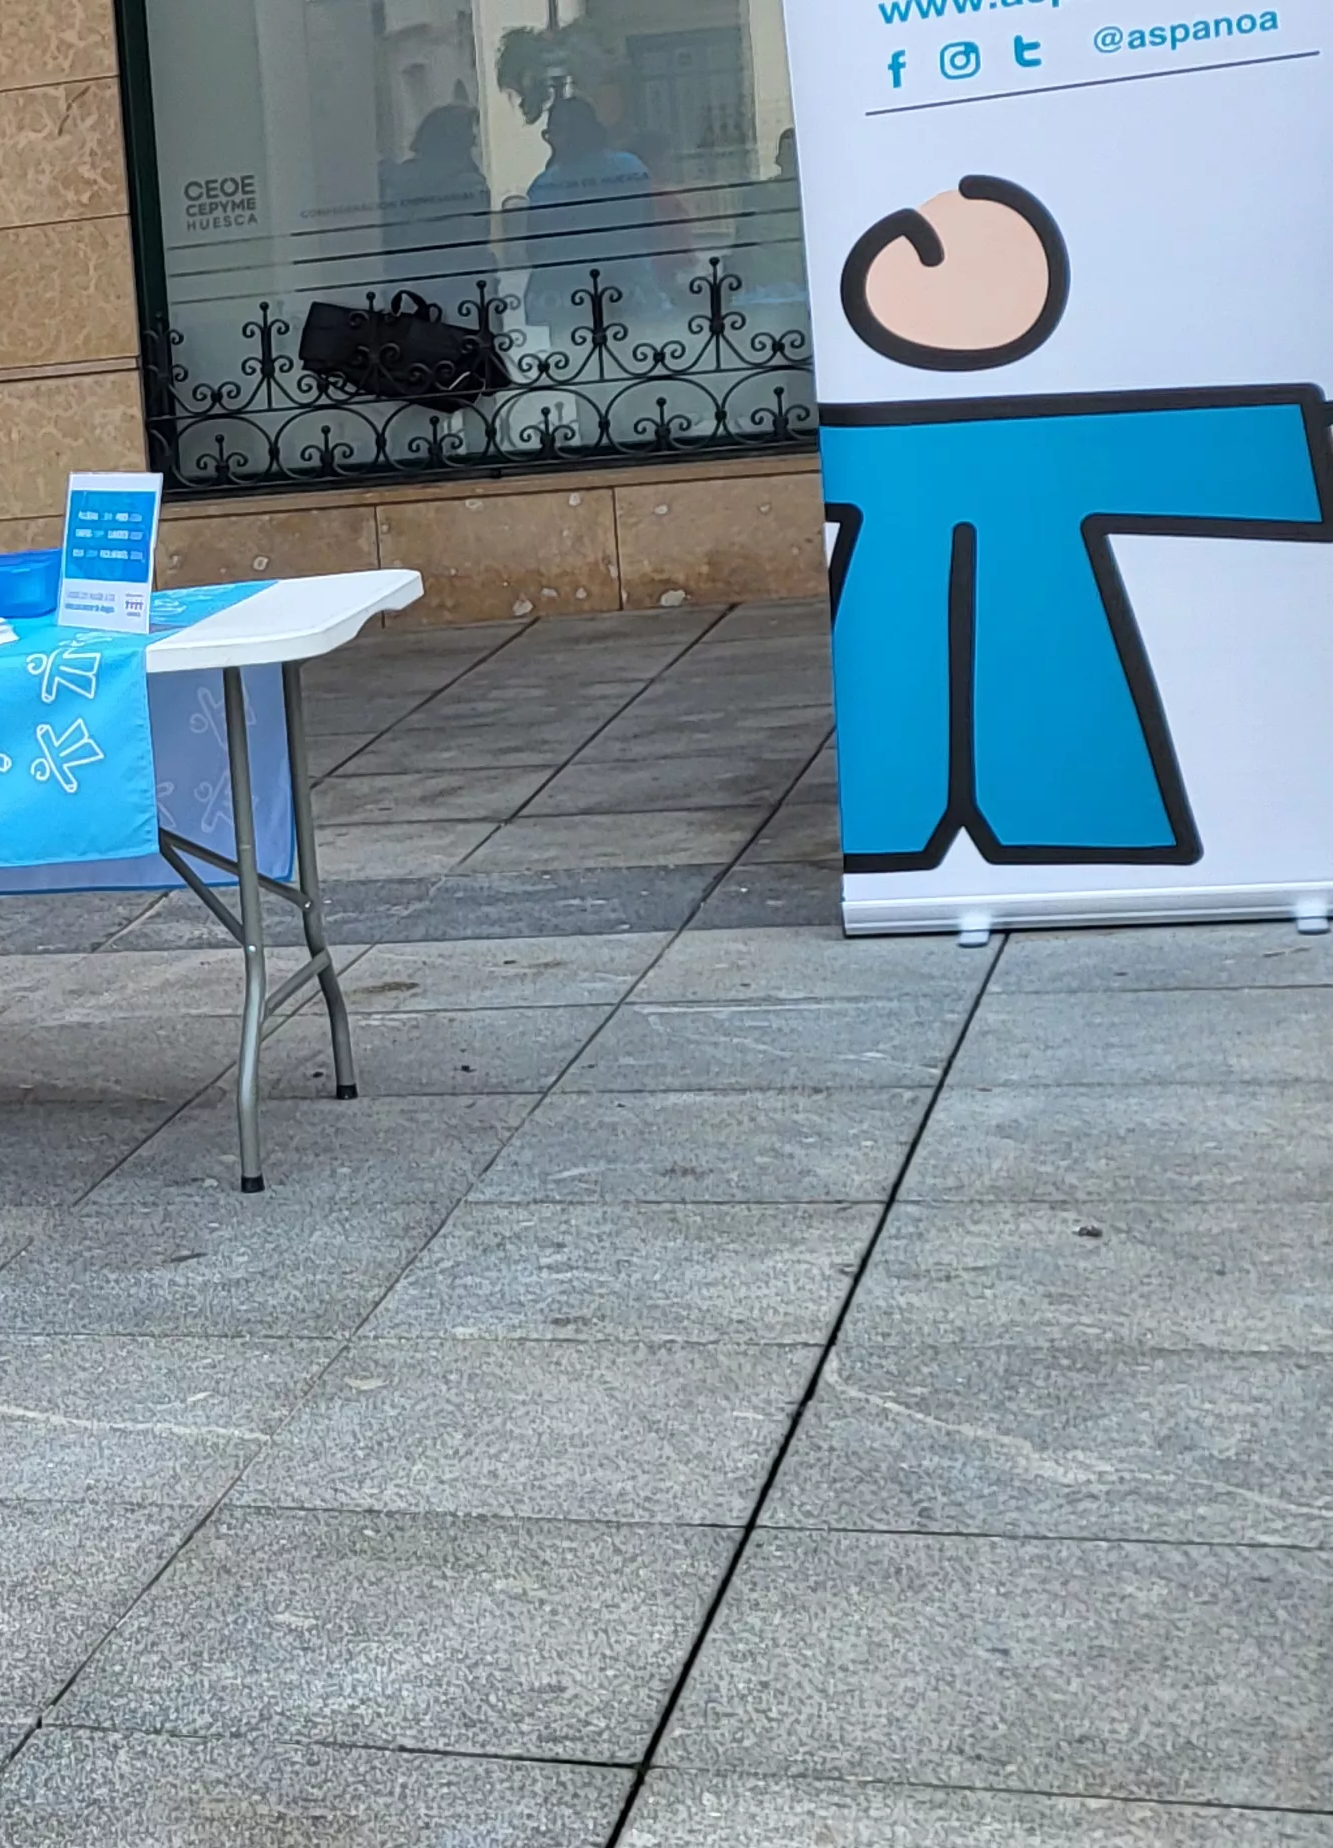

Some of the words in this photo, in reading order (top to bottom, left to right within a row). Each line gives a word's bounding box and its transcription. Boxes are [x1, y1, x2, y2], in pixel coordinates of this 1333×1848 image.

[1094, 10, 1278, 53] @aspanoa
[184, 175, 257, 201] CEOE
[186, 198, 257, 217] CEPYME
[187, 213, 258, 231] HUESCA
